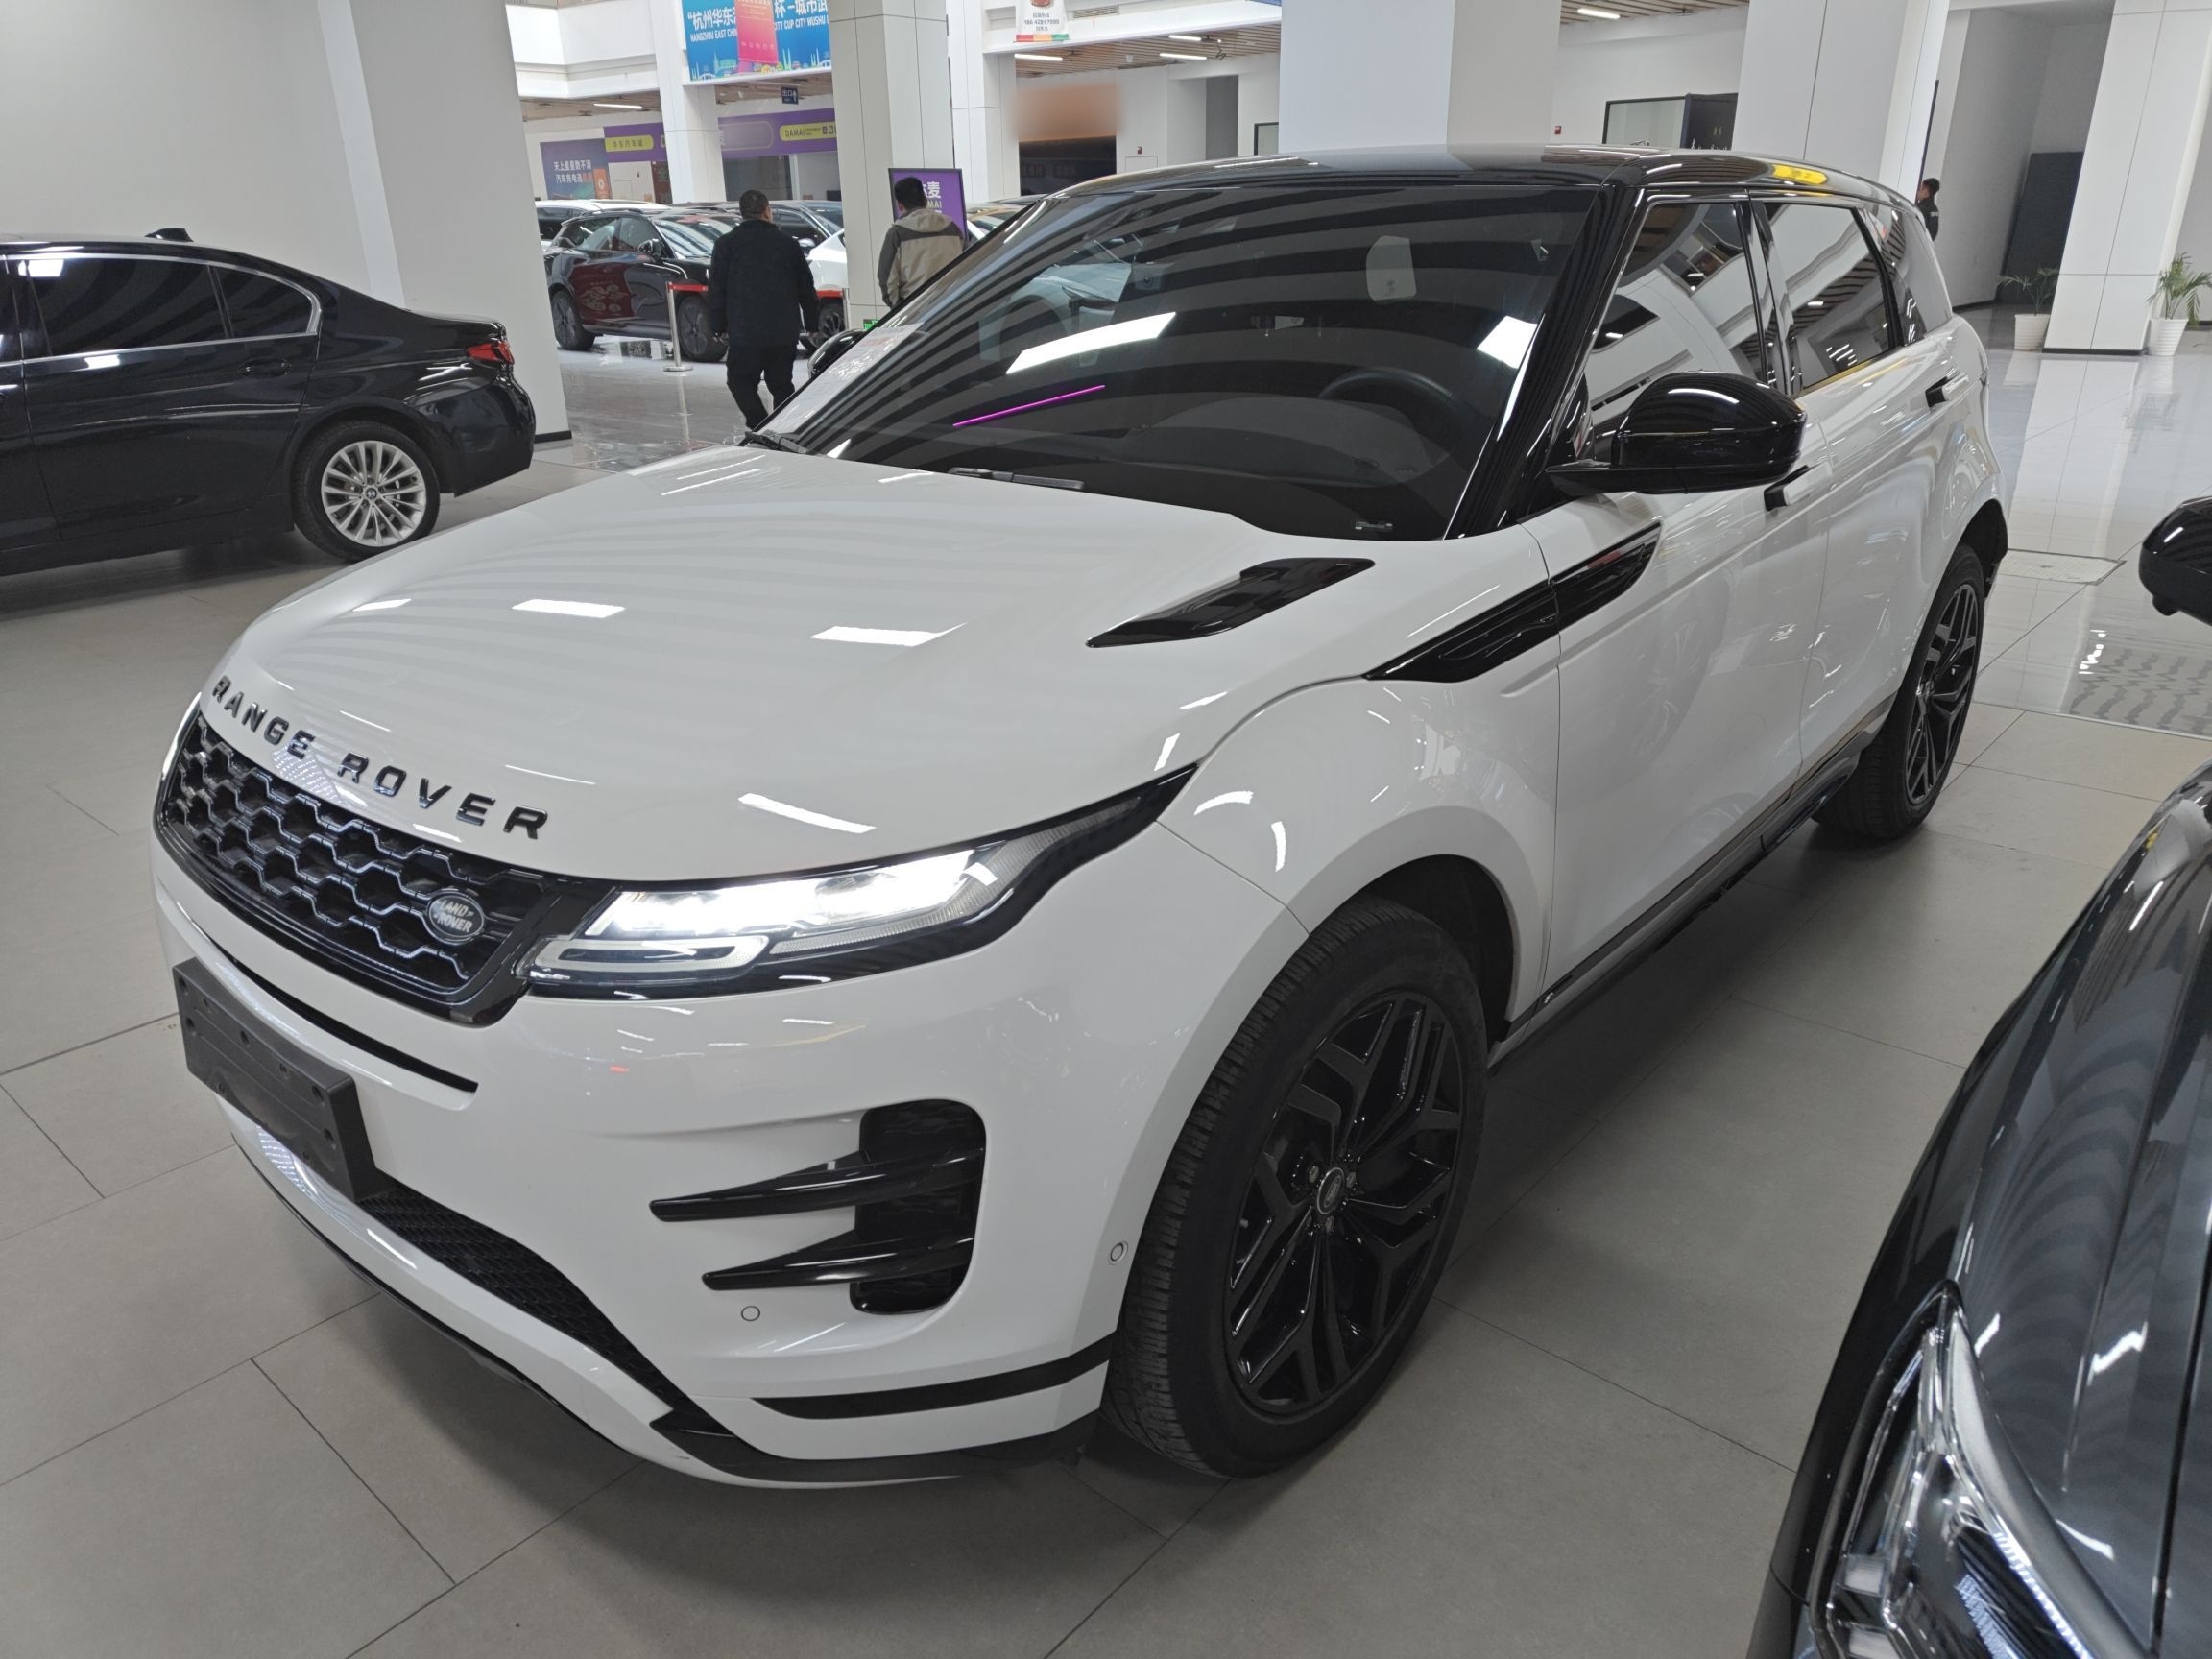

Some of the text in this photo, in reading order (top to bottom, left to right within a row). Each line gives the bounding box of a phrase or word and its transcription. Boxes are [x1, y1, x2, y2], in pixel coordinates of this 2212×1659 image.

[689, 31, 714, 42] HANGZHOU
[714, 29, 727, 39] EAST
[783, 19, 795, 30] CUP
[795, 18, 806, 28] CITY
[806, 15, 826, 27] WUSHU
[784, 128, 805, 138] DAMAI
[925, 200, 942, 208] MAI
[211, 675, 549, 841] RANGE ROVER
[441, 899, 469, 918] LAND
[437, 912, 473, 933] ROVER
